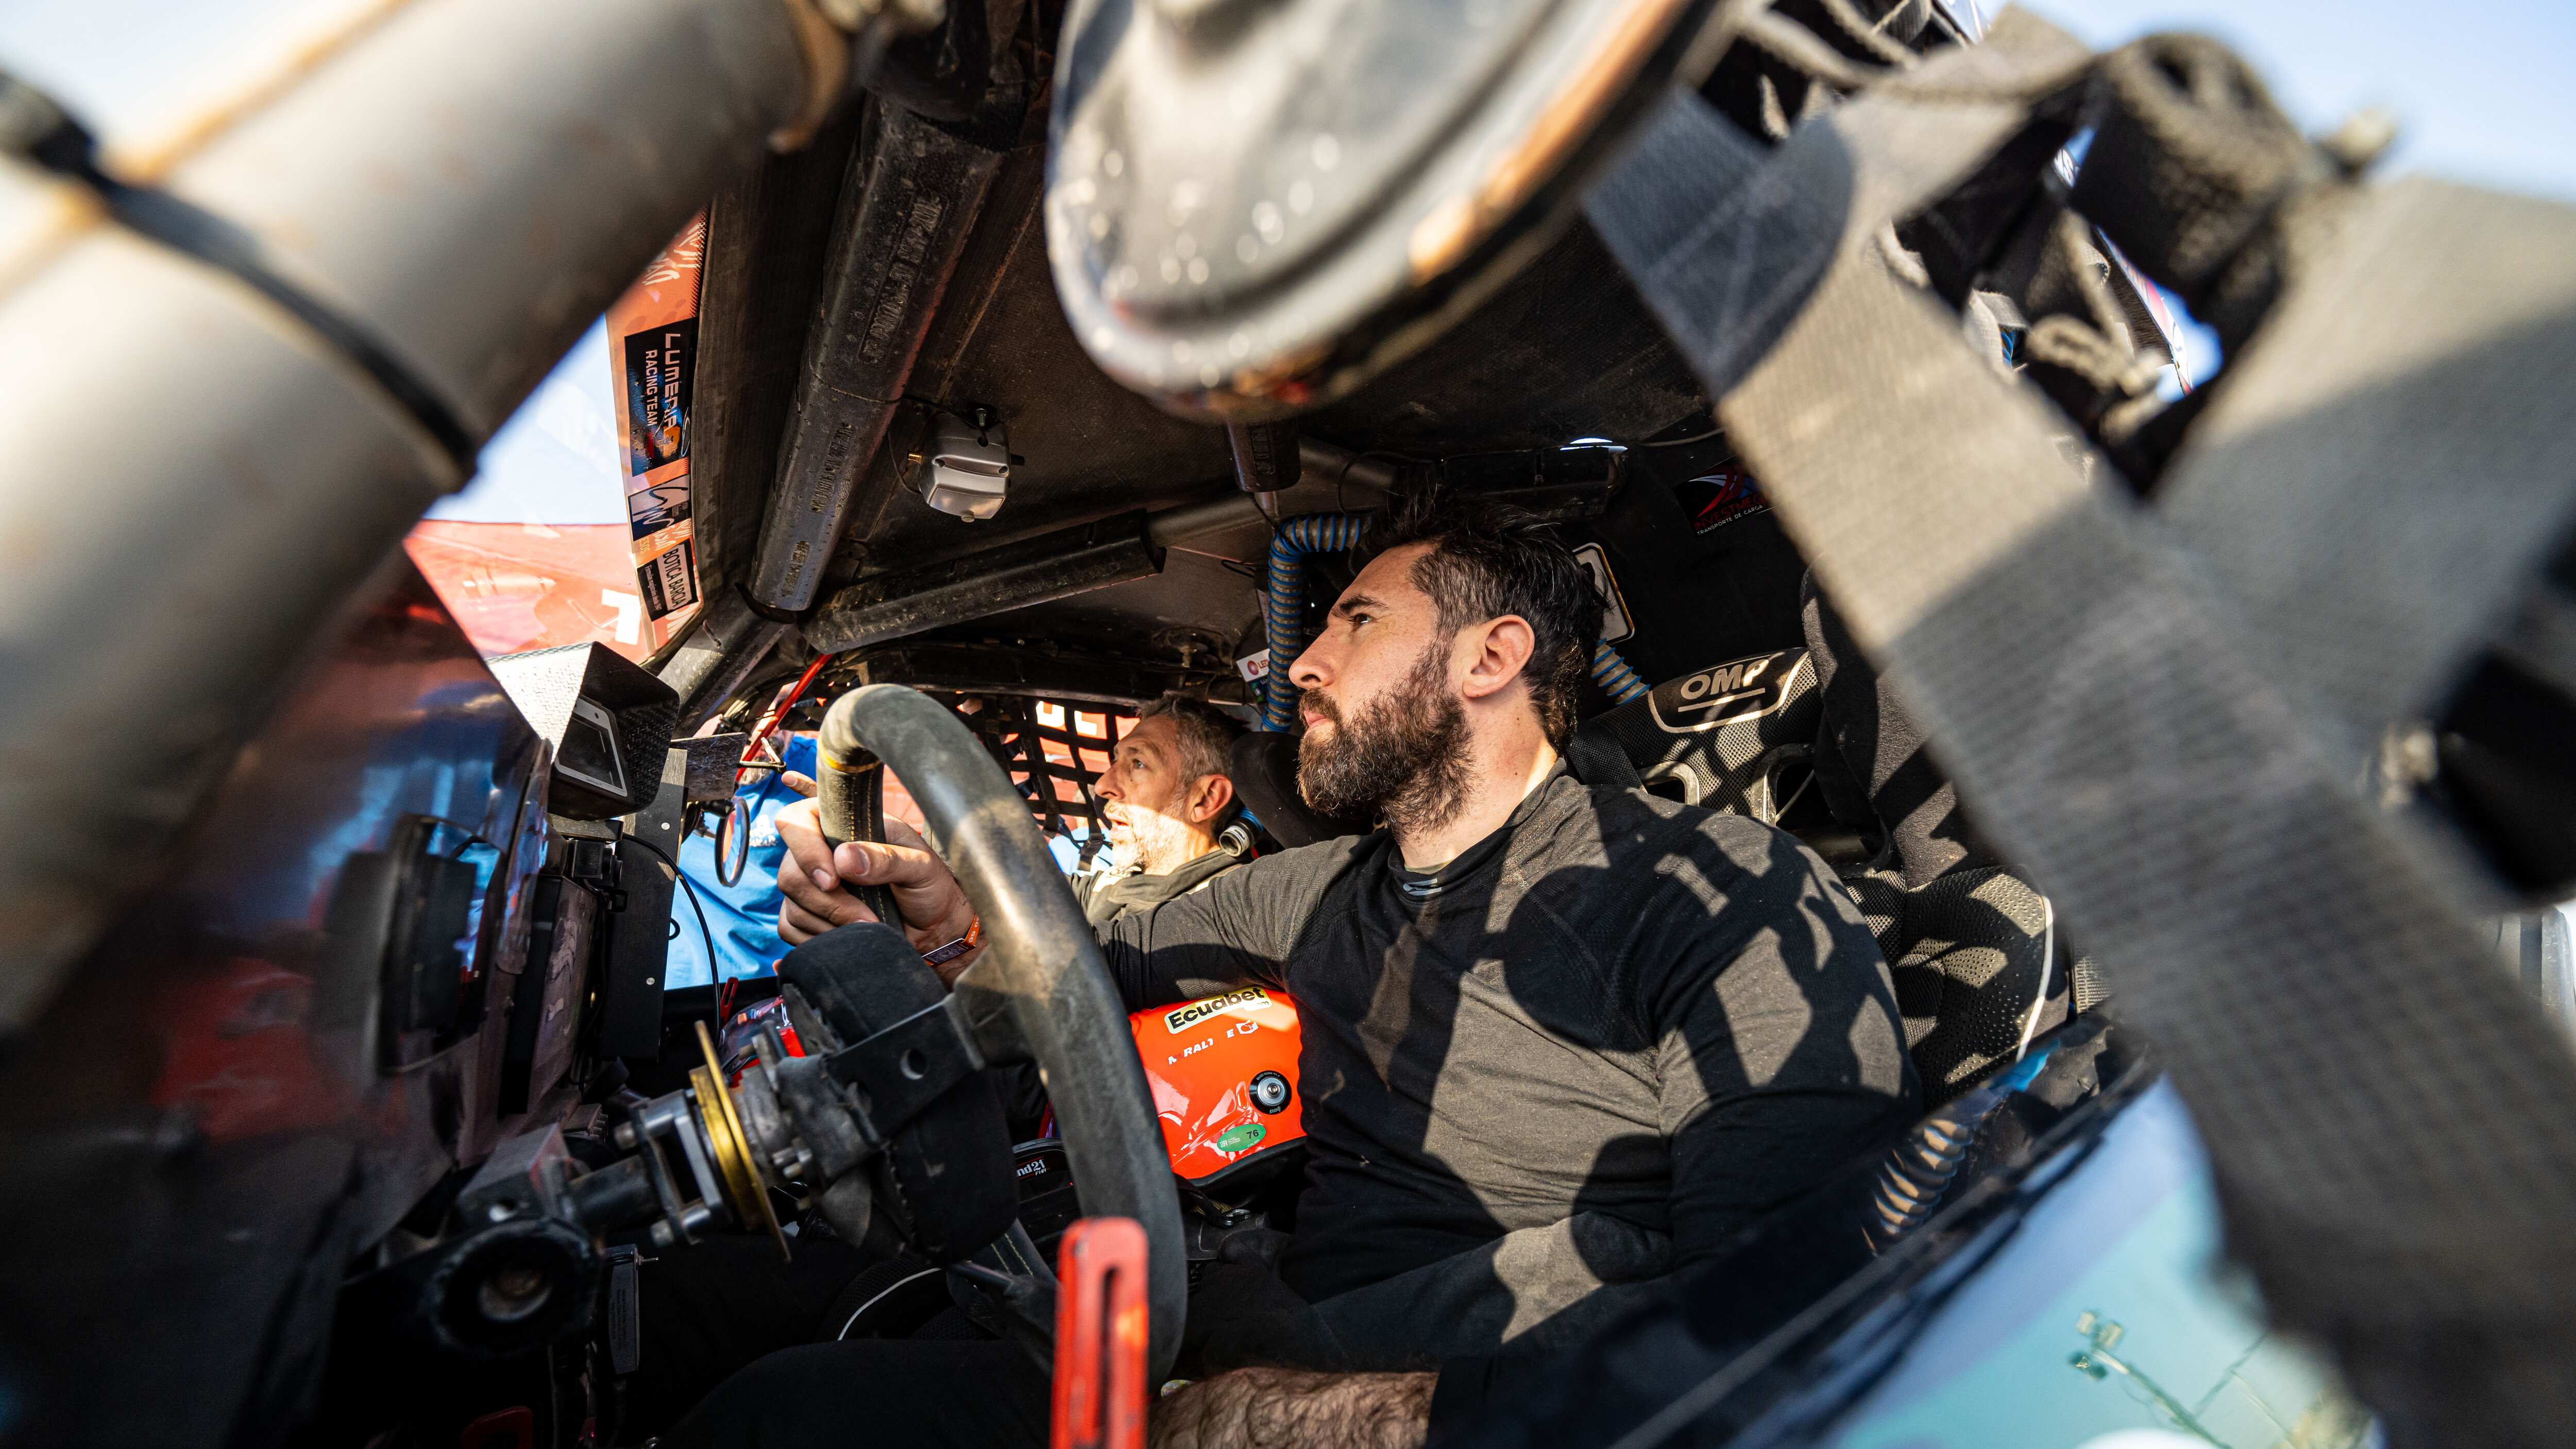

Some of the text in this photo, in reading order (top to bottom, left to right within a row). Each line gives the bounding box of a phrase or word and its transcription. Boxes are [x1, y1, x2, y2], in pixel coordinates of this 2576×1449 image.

[646, 349, 658, 426] RACING TEAM
[1697, 517, 1733, 535] TRANSPORTE
[1744, 504, 1763, 515] CARGA
[663, 548, 682, 581] BOTICA
[667, 579, 687, 607] BARCIA
[1680, 660, 1770, 700] OMP
[1168, 987, 1265, 1029] Ecuabet
[1246, 1130, 1259, 1139] 76
[1035, 1168, 1047, 1176] FHR
